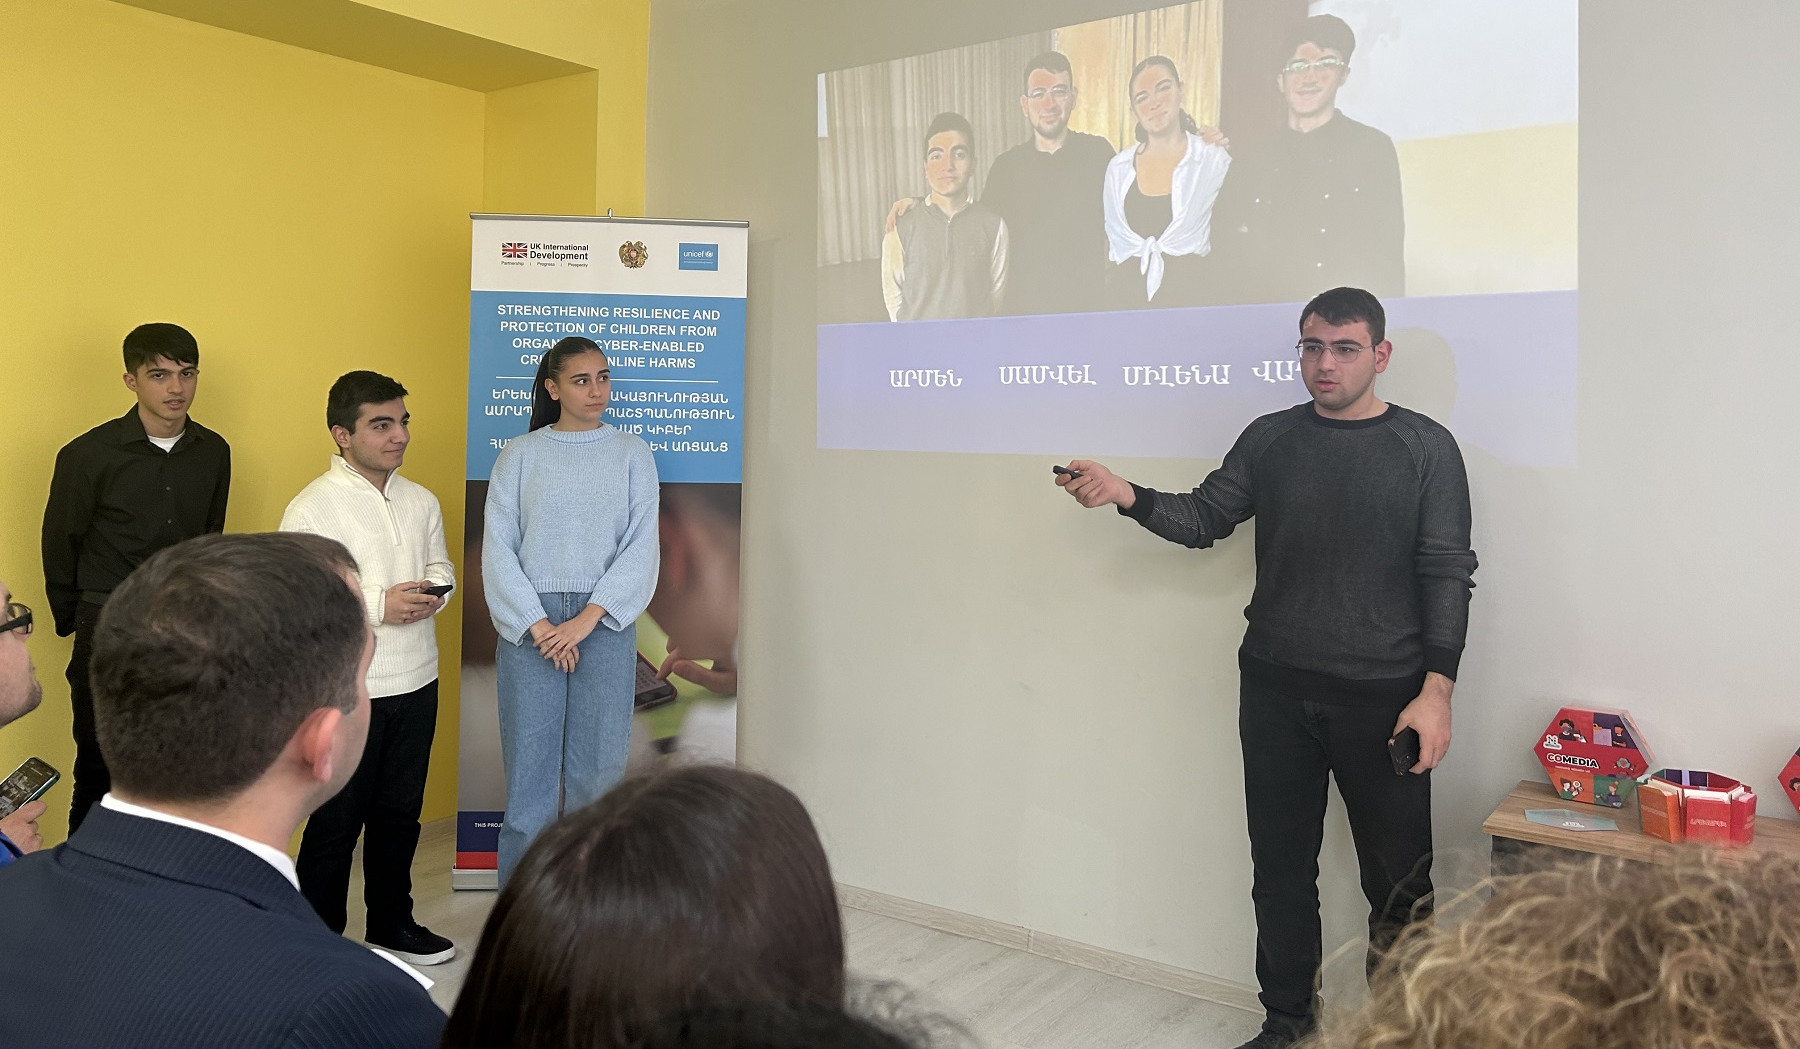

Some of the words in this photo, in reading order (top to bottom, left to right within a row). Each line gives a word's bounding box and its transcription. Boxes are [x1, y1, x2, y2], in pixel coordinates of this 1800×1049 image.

[543, 243, 589, 251] International
[530, 251, 589, 261] Development
[683, 250, 704, 258] unicef
[497, 304, 609, 318] STRENGTHENING
[613, 307, 690, 320] RESILIENCE
[693, 310, 721, 321] AND
[500, 321, 585, 334] PROTECTION
[589, 323, 607, 334] OF
[610, 323, 676, 336] CHILDREN
[680, 326, 717, 337] FROM
[512, 338, 559, 349] ORGAN
[596, 339, 705, 353] CYBER-ENABLED
[607, 356, 646, 368] NLINE
[649, 357, 696, 369] HARMS
[888, 369, 963, 388] ԱՐՄԵՆ
[998, 364, 1097, 386] ՍԱՄՎԵԼ
[1122, 364, 1231, 388] ՄԻԼԵՆԱ
[1251, 360, 1301, 384] ՎԱ
[492, 389, 532, 400] ԵՐԵԽ
[610, 391, 729, 404] ԱԿԱՅՈՒՆՈՒԹՅԱՆ
[485, 405, 533, 416] ԱՄՐԱՊ
[647, 424, 692, 436] ԿԻԲԵՐ
[672, 441, 729, 453] ԱՌՑԱՆՑ
[1547, 753, 1599, 769] COMEDIA
